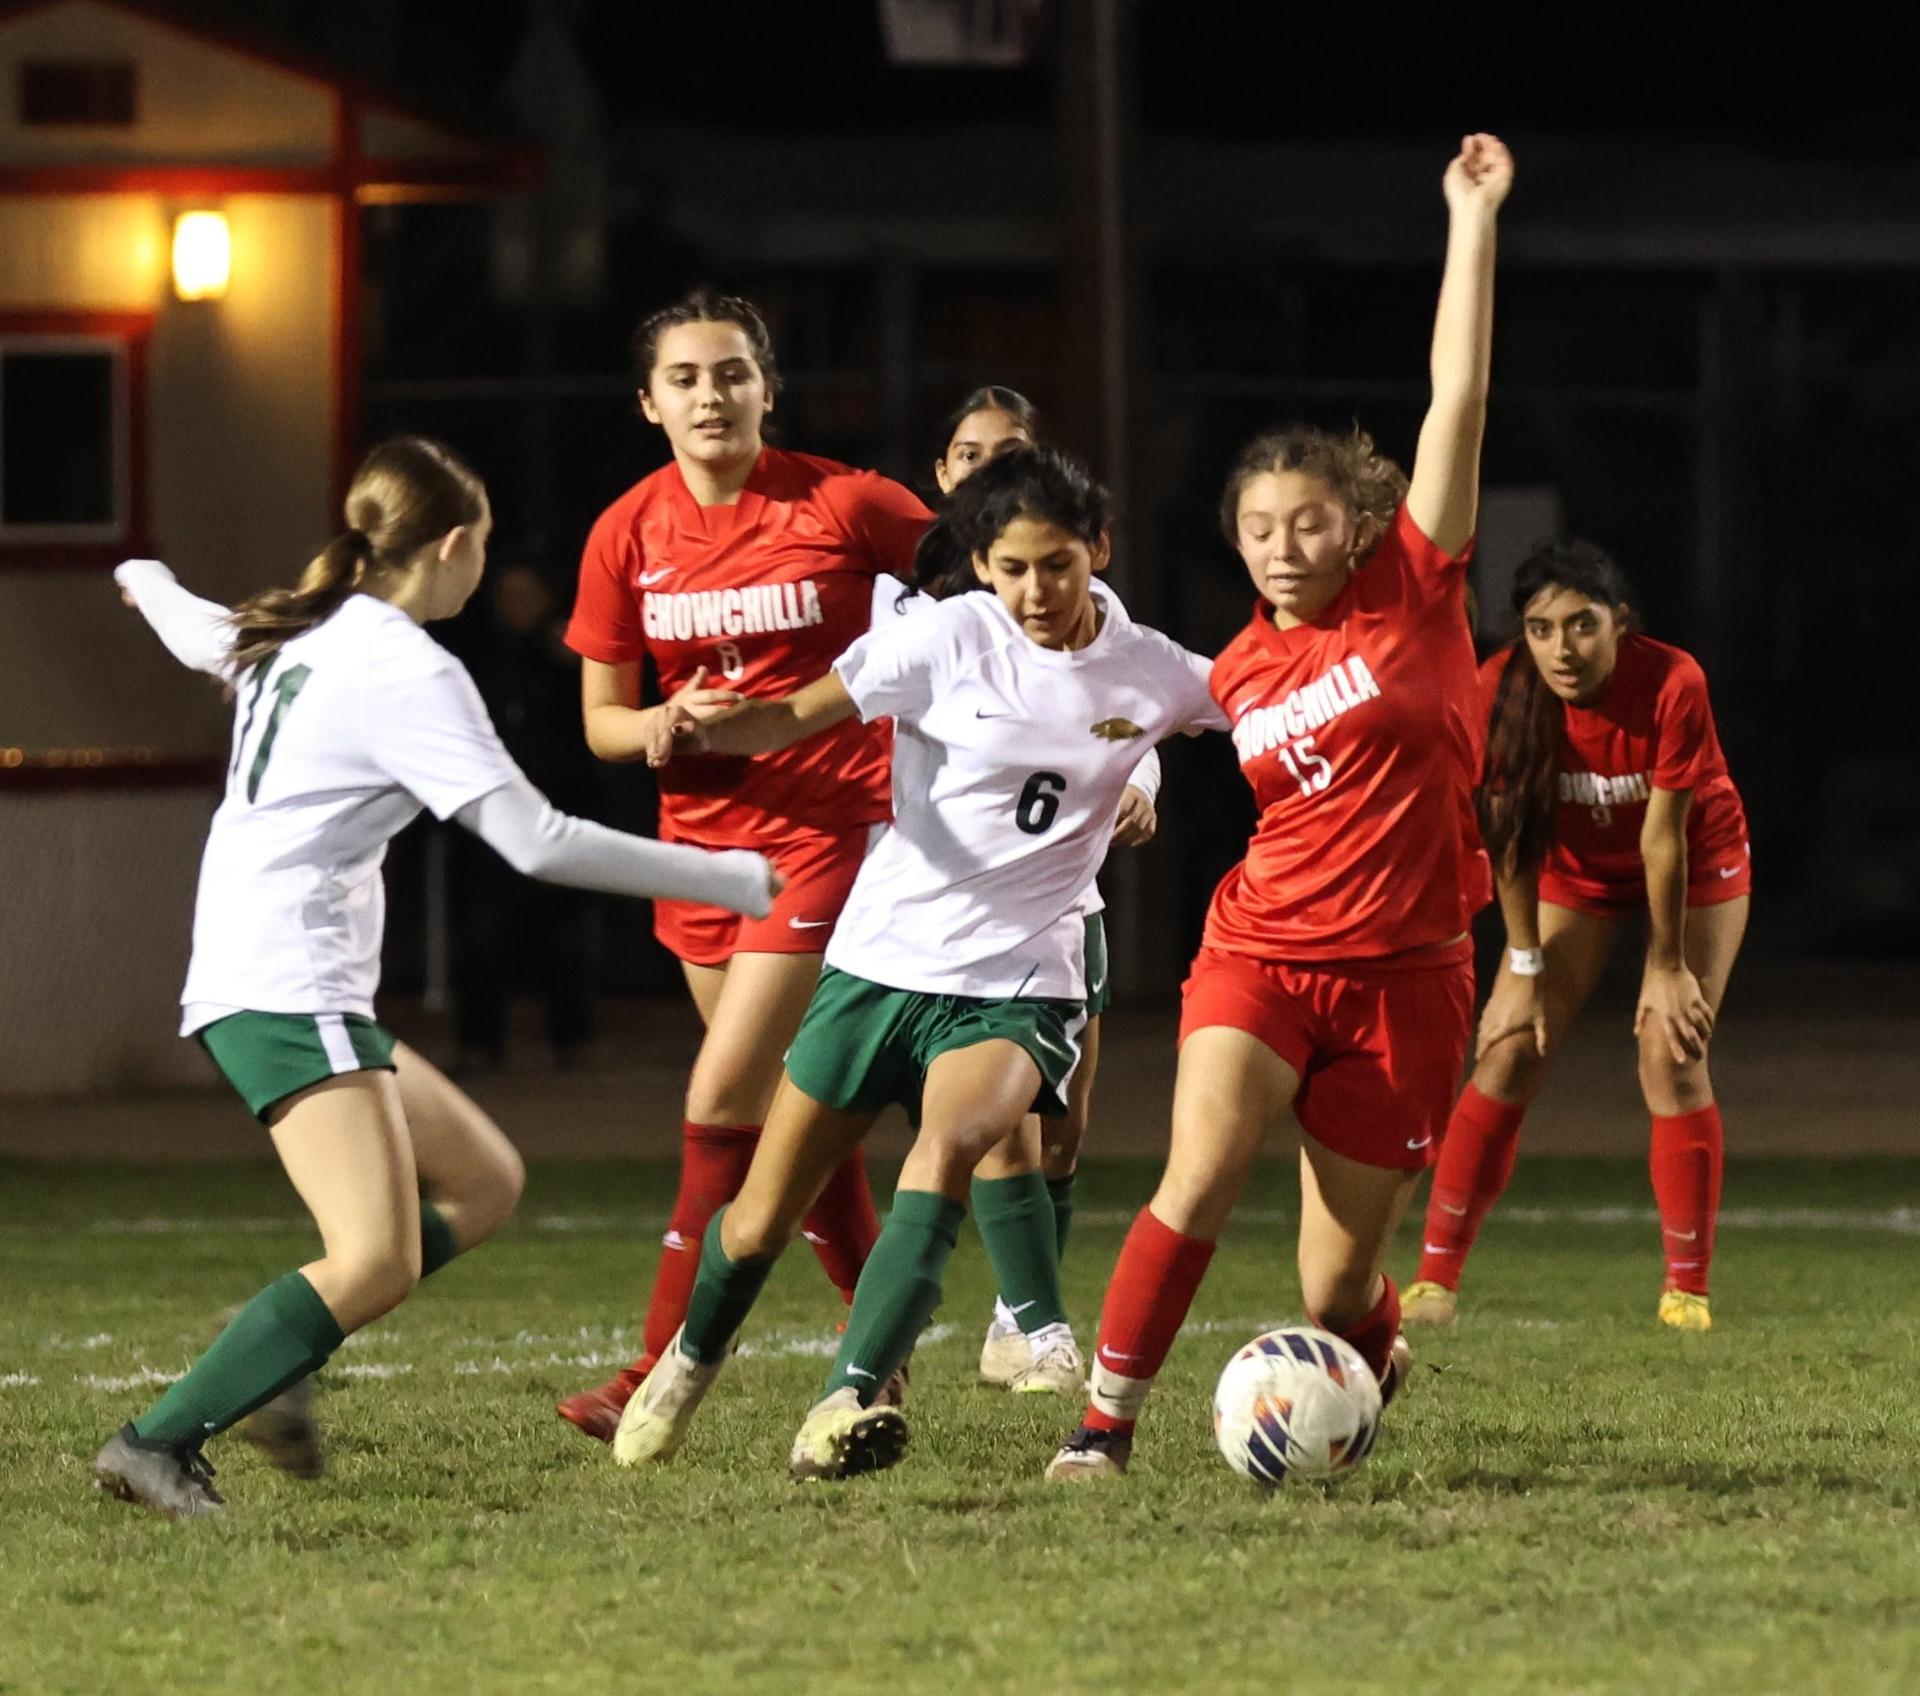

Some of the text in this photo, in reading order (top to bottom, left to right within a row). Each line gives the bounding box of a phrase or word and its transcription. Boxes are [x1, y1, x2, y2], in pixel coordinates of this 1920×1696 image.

[643, 580, 824, 641] CHOWCHILLA
[717, 640, 744, 681] 8
[1279, 734, 1332, 797] 15
[1015, 771, 1067, 835] 6
